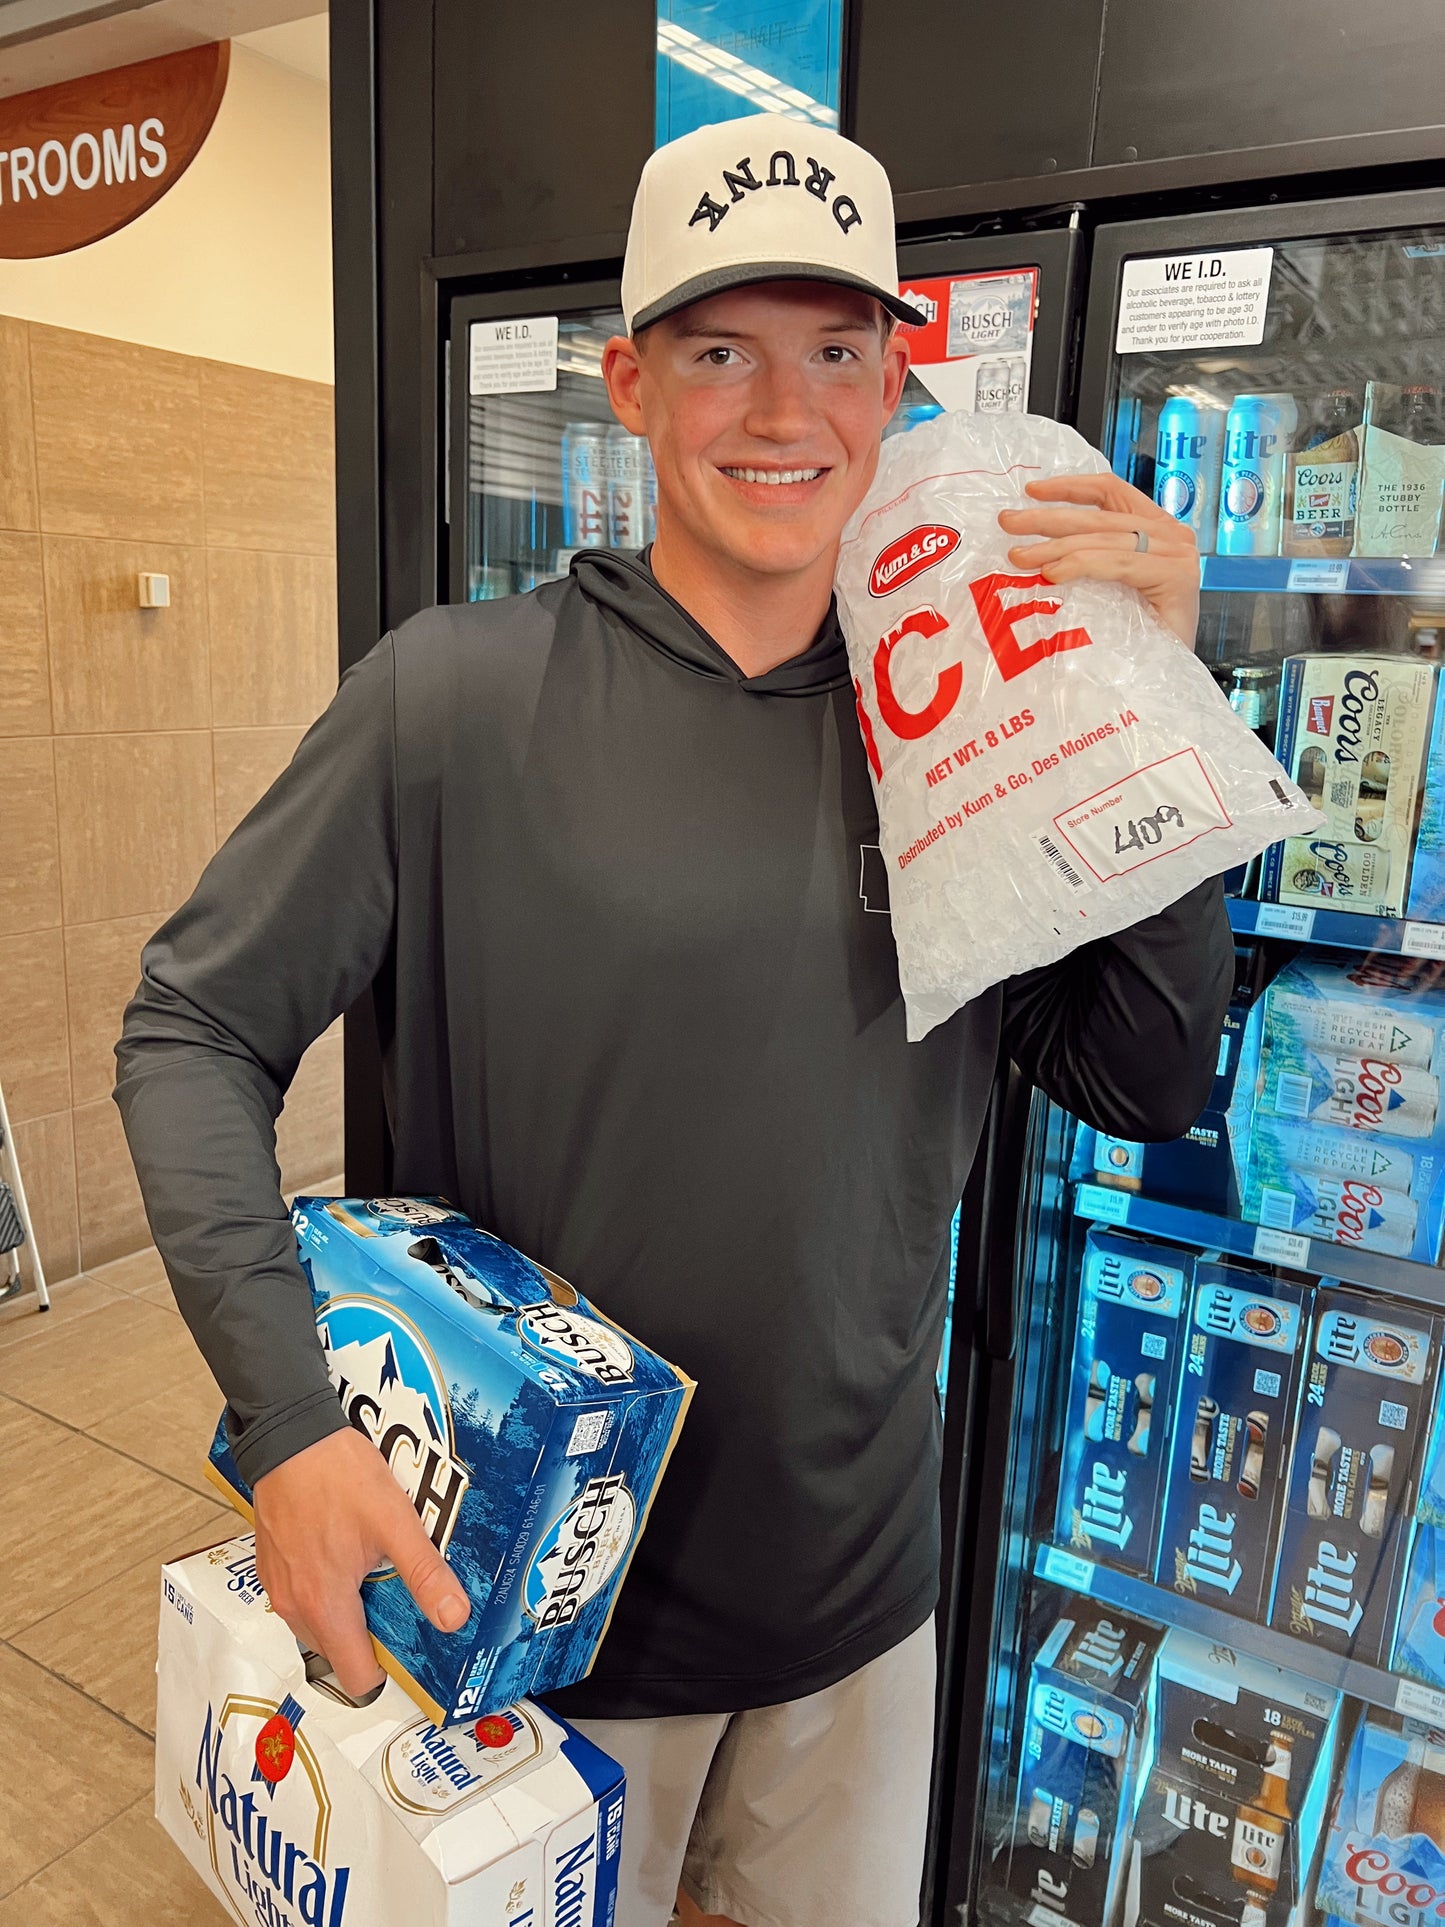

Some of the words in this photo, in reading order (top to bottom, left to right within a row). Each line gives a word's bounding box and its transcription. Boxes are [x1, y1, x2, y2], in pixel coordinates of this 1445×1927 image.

[689, 150, 863, 235] DRUNK
[1165, 262, 1192, 282] WE
[1198, 259, 1226, 279] I.D.
[1126, 300, 1158, 310] alcoholic
[1159, 297, 1195, 308] beverage,
[1197, 294, 1226, 304] tobacco
[1236, 291, 1260, 301] lottery
[1127, 289, 1140, 298] Our
[1141, 286, 1180, 296] associates
[1181, 285, 1194, 293] are
[1195, 281, 1226, 292] required
[1228, 280, 1235, 288] to
[1237, 279, 1251, 287] ask
[1253, 278, 1262, 286] all
[961, 311, 1012, 332] BUSCH
[1121, 325, 1134, 334] and
[1136, 323, 1157, 333] under
[1158, 323, 1166, 331] to
[1168, 321, 1188, 332] verify
[1189, 321, 1203, 331] age
[1205, 319, 1221, 328] with
[1223, 317, 1245, 328] photo
[1129, 312, 1166, 322] customers
[1168, 309, 1205, 320] appearing
[1206, 308, 1214, 316] to
[1216, 307, 1226, 315] be
[1227, 306, 1242, 315] age
[1243, 304, 1253, 313] 30
[495, 326, 512, 341] WE
[515, 325, 532, 339] I.D.
[970, 329, 1001, 340] LIGHT
[1132, 336, 1153, 345] Thank
[1155, 336, 1168, 345] you
[1169, 334, 1180, 343] for
[1181, 334, 1198, 343] your
[1200, 331, 1246, 341] cooperation.
[977, 387, 1007, 401] BUSCH
[1157, 430, 1207, 468] Lite
[1224, 429, 1278, 468] Lite
[1297, 468, 1344, 486] Coors
[613, 491, 633, 537] 211
[1296, 508, 1341, 521] BEER
[1379, 494, 1421, 502] STUBBY
[1379, 504, 1420, 512] BOTTLE
[875, 553, 909, 589] Kum
[910, 543, 921, 560] &
[921, 532, 950, 555] Go
[1334, 669, 1380, 765] Coors
[1373, 699, 1385, 742] LEGACY
[925, 760, 954, 789] NET
[955, 740, 985, 768] WT.
[985, 731, 999, 749] 8
[1000, 708, 1036, 740] LBS
[897, 821, 947, 872] Distributed
[948, 813, 963, 830] by
[962, 790, 994, 819] Kum
[995, 783, 1008, 798] &
[1007, 771, 1033, 791] Go,
[1032, 751, 1060, 777] Des
[1059, 720, 1120, 760] Moines,
[1120, 709, 1140, 729] IA
[1067, 812, 1090, 830] Store
[1090, 793, 1124, 818] Number
[1114, 805, 1185, 854] 409
[1309, 842, 1354, 897] Coors
[1360, 852, 1371, 897] GOLDEN
[1331, 1012, 1388, 1030] REFRESH
[1331, 1024, 1386, 1040] RECYCLE
[1330, 1034, 1385, 1051] REPEAT
[1329, 1057, 1358, 1127] LIGHT
[1315, 1145, 1367, 1163] RECYCLE
[1316, 1137, 1369, 1154] REFRESH
[1313, 1155, 1366, 1174] REPEAT
[1420, 1155, 1434, 1170] 18
[291, 1208, 309, 1235] 12
[384, 1198, 440, 1226] BUSC
[1312, 1178, 1340, 1241] LIGHT
[1097, 1256, 1126, 1300] Lite
[1206, 1288, 1237, 1334] Lite
[521, 1302, 631, 1384] BUSCH
[1080, 1318, 1097, 1341] 24
[1327, 1316, 1360, 1364] Lite
[538, 1368, 570, 1392] 12
[1187, 1353, 1205, 1377] 24
[1109, 1374, 1121, 1406] TASTE
[1307, 1383, 1325, 1408] 24
[1104, 1405, 1117, 1440] MORE
[1217, 1412, 1231, 1449] TASTE
[1212, 1447, 1226, 1481] MORE
[1339, 1446, 1353, 1486] TASTE
[1081, 1462, 1134, 1551] Lite
[1333, 1483, 1348, 1518] MORE
[494, 1567, 517, 1607] 22AUG24
[512, 1530, 531, 1565] SA0029
[524, 1482, 547, 1530] 61-246-01
[537, 1476, 624, 1632] BUSCH
[592, 1525, 613, 1570] BEER
[1184, 1503, 1243, 1596] Lite
[163, 1578, 176, 1605] 15
[238, 1589, 256, 1606] BEER
[1300, 1540, 1364, 1638] Lite
[176, 1599, 194, 1626] CANS
[1071, 1619, 1127, 1678] Lite
[452, 1685, 482, 1719] 12
[1042, 1691, 1068, 1733] Lite
[1263, 1708, 1282, 1726] 18
[410, 1750, 441, 1784] Light
[416, 1723, 483, 1791] Natural
[1029, 1741, 1042, 1761] 18
[1181, 1747, 1208, 1765] MORE
[1208, 1758, 1238, 1777] TASTE
[195, 1699, 350, 1927] Natural
[606, 1795, 624, 1826] 15
[1161, 1786, 1230, 1839] Lite
[606, 1828, 615, 1861] CANS
[1242, 1825, 1275, 1849] Lite
[1163, 1903, 1188, 1920] MORE
[1189, 1913, 1217, 1927] TASTE
